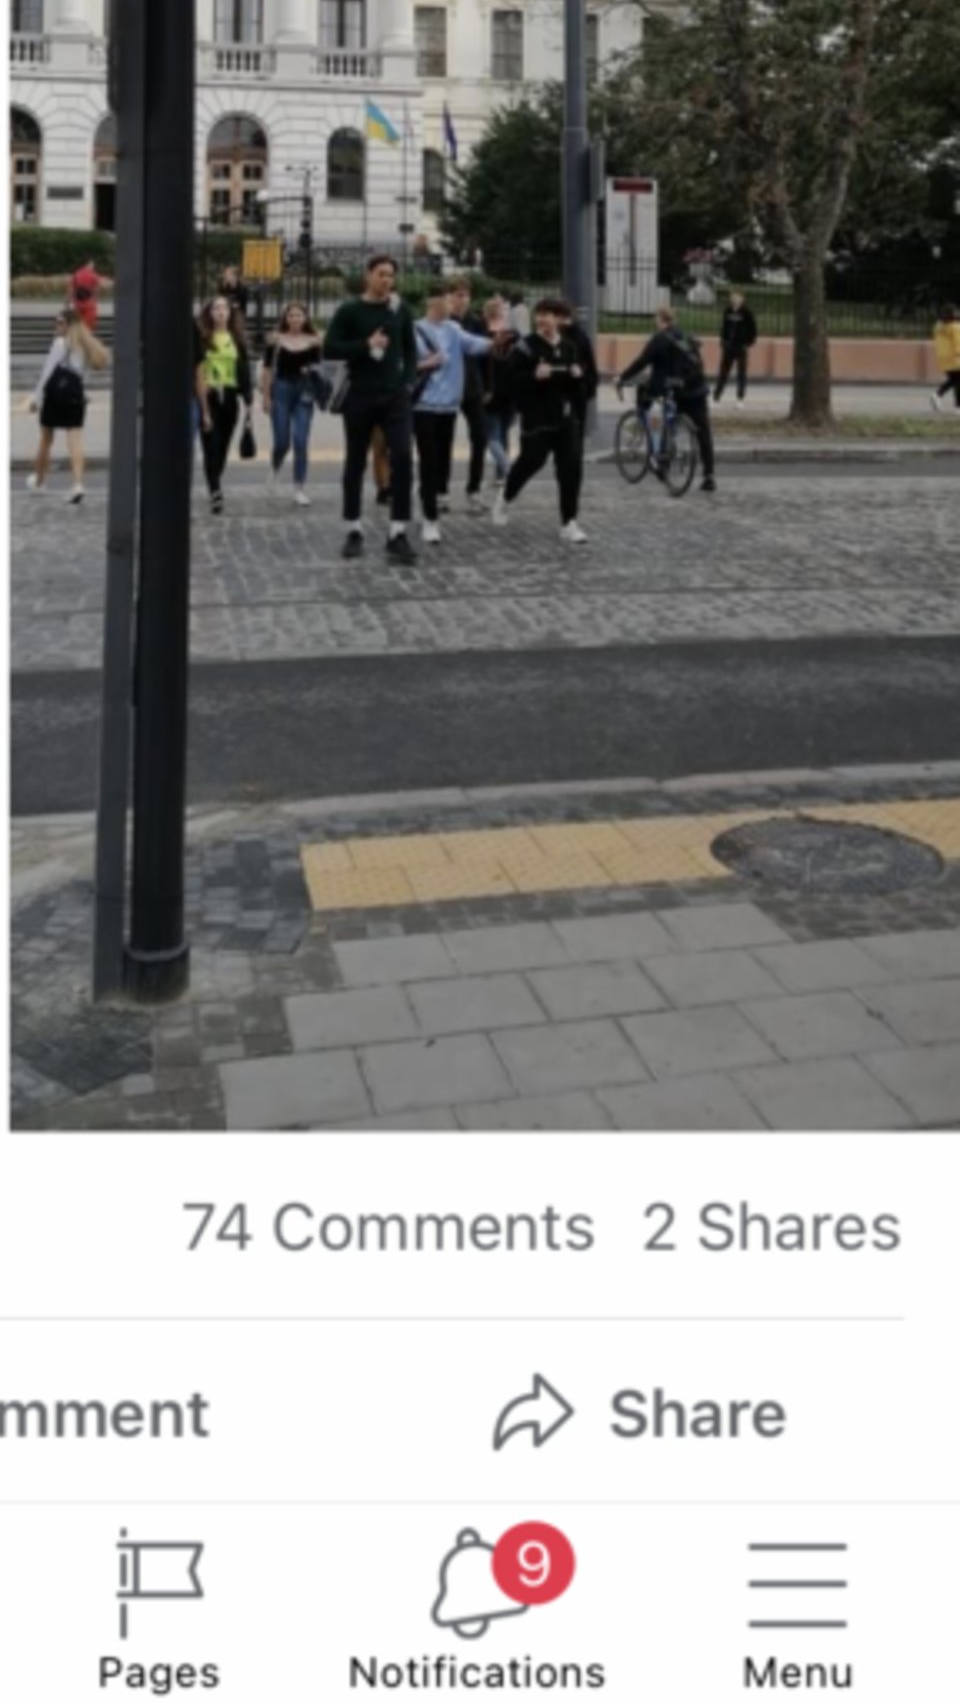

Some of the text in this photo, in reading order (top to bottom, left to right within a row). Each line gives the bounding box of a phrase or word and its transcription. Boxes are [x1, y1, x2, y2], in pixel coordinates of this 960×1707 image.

[184, 1203, 593, 1251] 74 Comments
[646, 1202, 899, 1251] 2 Shares
[612, 1388, 785, 1438] Share
[518, 1540, 551, 1588] 9
[100, 1656, 219, 1695] Pages
[350, 1656, 604, 1688] Notifications
[744, 1657, 851, 1688] Menu
